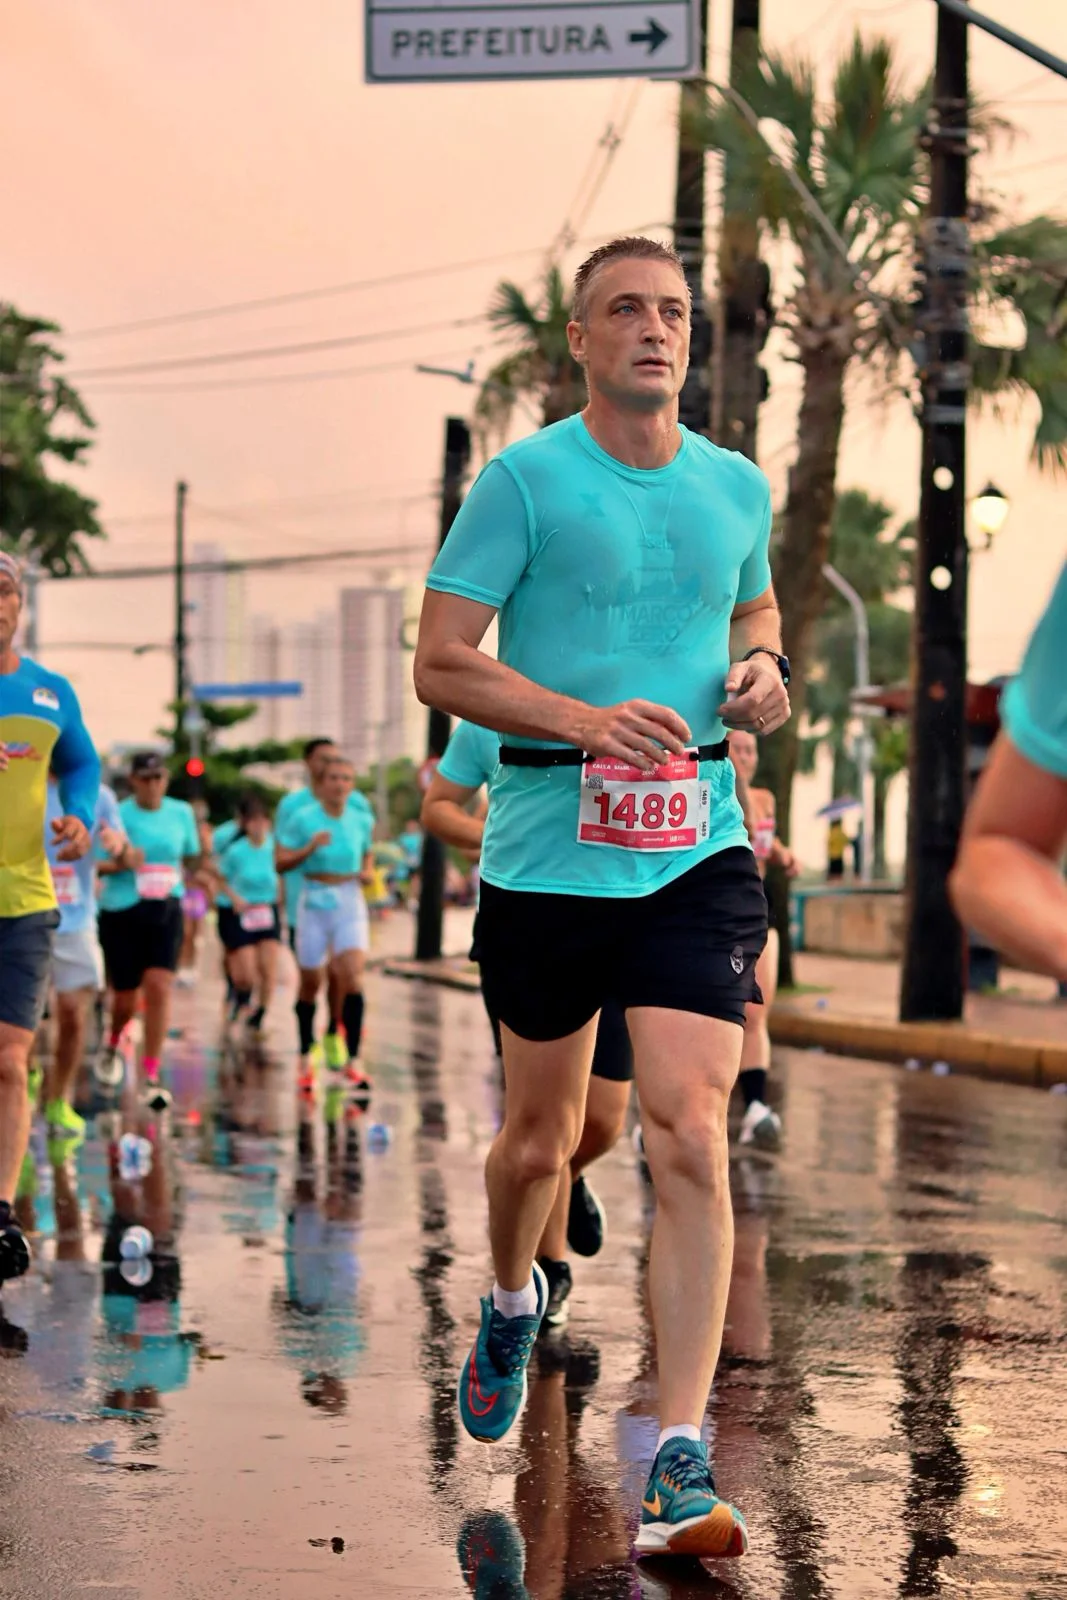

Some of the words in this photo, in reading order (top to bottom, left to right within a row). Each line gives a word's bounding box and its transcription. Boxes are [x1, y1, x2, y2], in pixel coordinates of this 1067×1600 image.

[390, 25, 612, 58] PREFEITURA
[622, 604, 691, 624] MARCO
[594, 791, 688, 830] 1489
